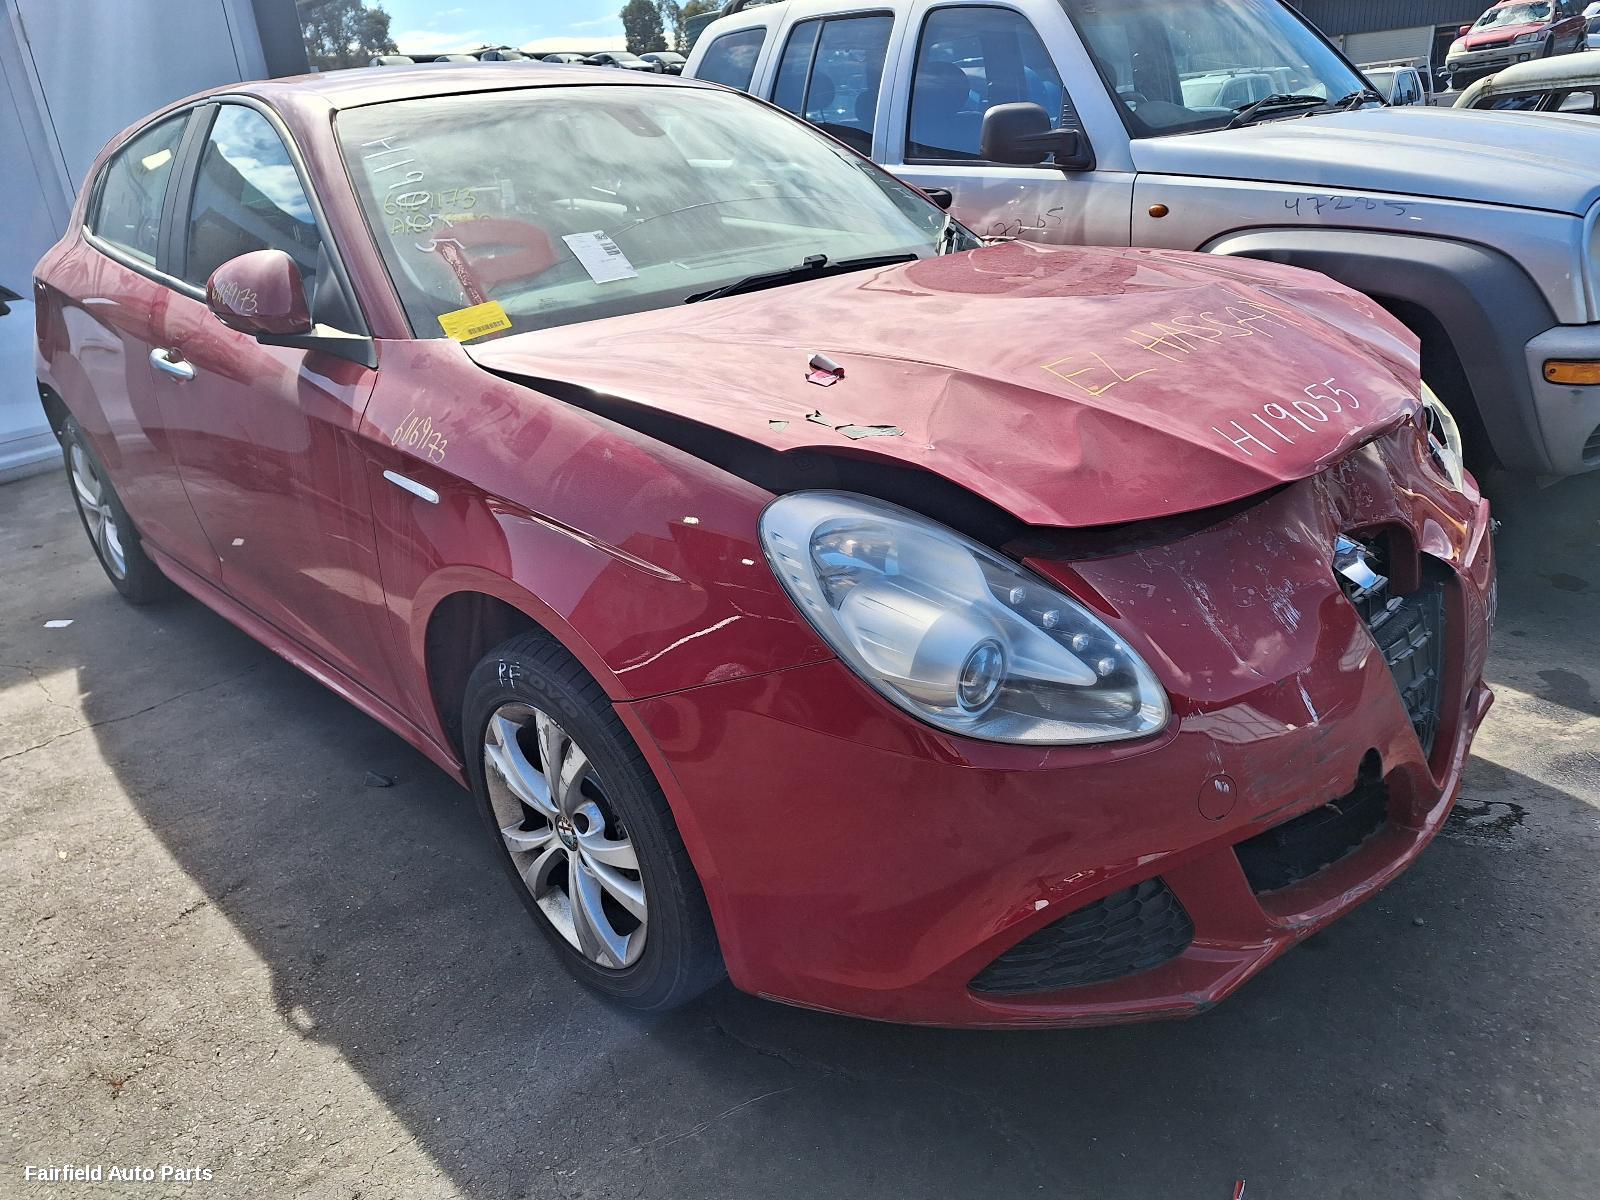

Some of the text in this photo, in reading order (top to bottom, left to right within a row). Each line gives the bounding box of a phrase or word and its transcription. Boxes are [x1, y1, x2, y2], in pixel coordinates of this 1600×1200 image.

[1040, 288, 1302, 398] EL HASSAN
[1211, 377, 1360, 456] H19055
